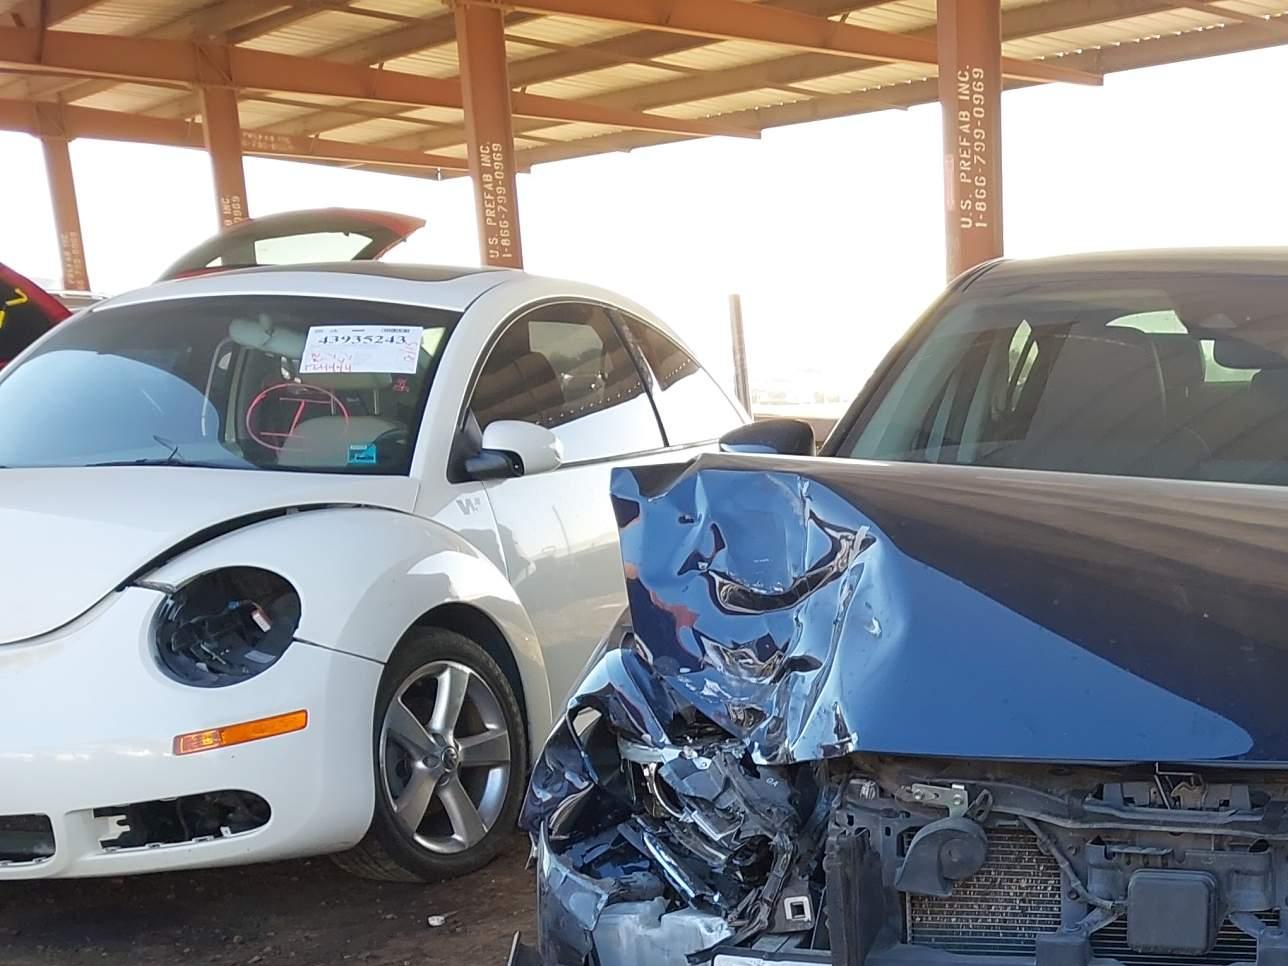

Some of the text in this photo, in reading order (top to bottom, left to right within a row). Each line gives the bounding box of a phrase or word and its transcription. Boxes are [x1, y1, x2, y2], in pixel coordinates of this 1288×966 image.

[480, 141, 499, 258] U.S. PREFAB INC.
[492, 143, 512, 258] 1-866-799-0969
[958, 64, 972, 228] U.S. PREFAB INC.
[972, 67, 987, 228] 1-866-799-0969
[318, 335, 406, 345] 43935243
